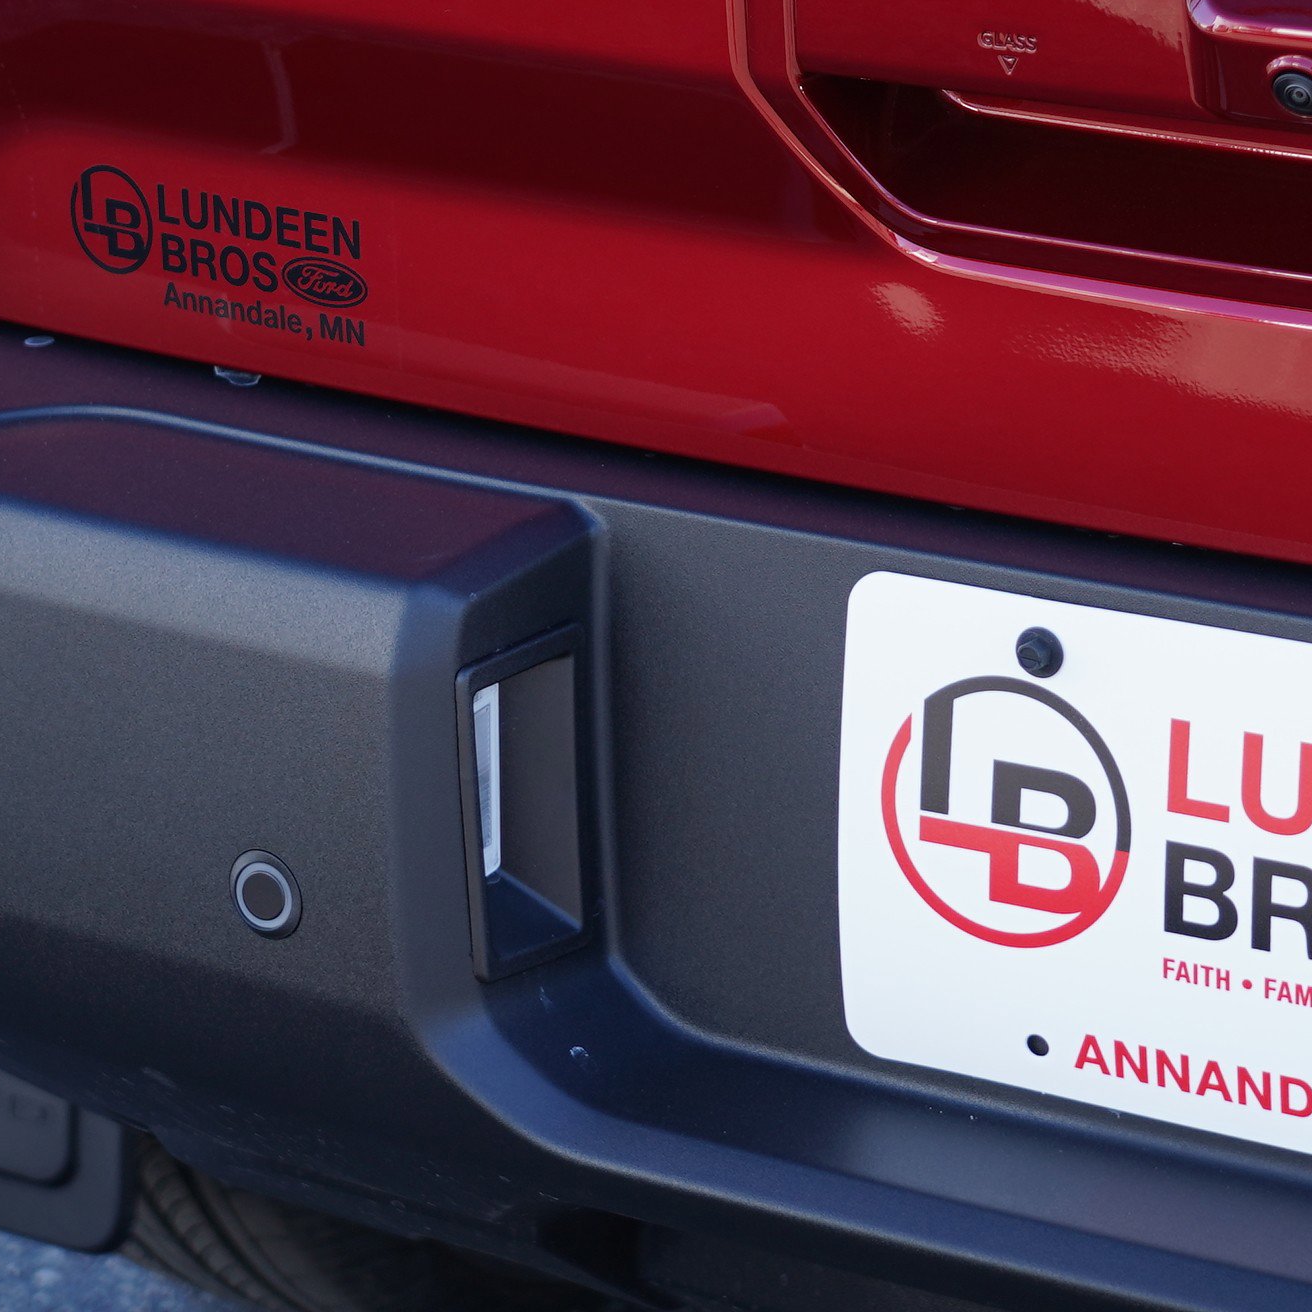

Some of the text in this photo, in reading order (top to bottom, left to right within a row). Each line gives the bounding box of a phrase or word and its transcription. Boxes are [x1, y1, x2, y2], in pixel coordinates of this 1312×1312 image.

[977, 31, 1038, 54] GLASS
[157, 184, 361, 260] LUNDEEN
[161, 233, 279, 293] BROS
[297, 266, 354, 298] Ford
[164, 282, 365, 347] Annandale, MN
[1162, 957, 1231, 991] FAITH
